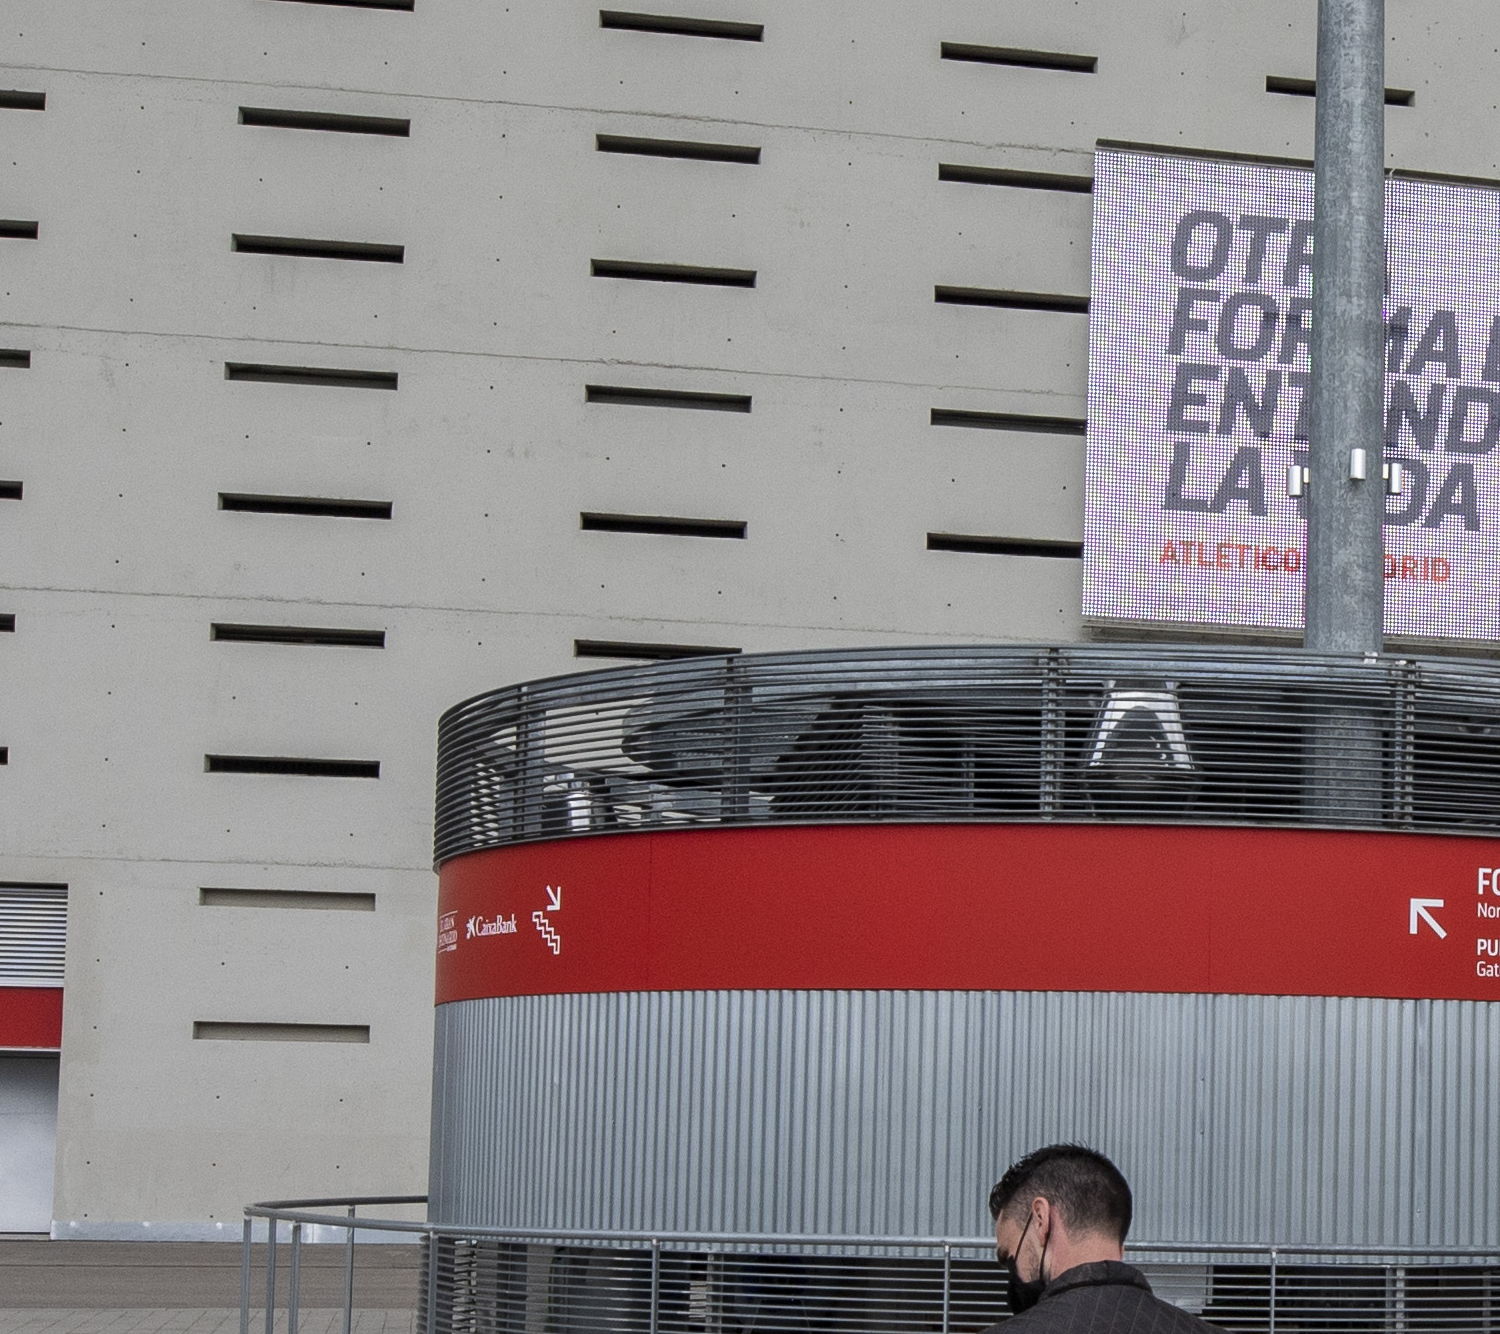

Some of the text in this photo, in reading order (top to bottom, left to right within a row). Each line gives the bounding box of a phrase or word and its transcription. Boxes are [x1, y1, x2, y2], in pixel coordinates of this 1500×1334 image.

[1170, 209, 1391, 297] OTR
[1167, 286, 1461, 380] FORA
[1164, 440, 1269, 517] LA
[475, 913, 518, 938] CaixaBank
